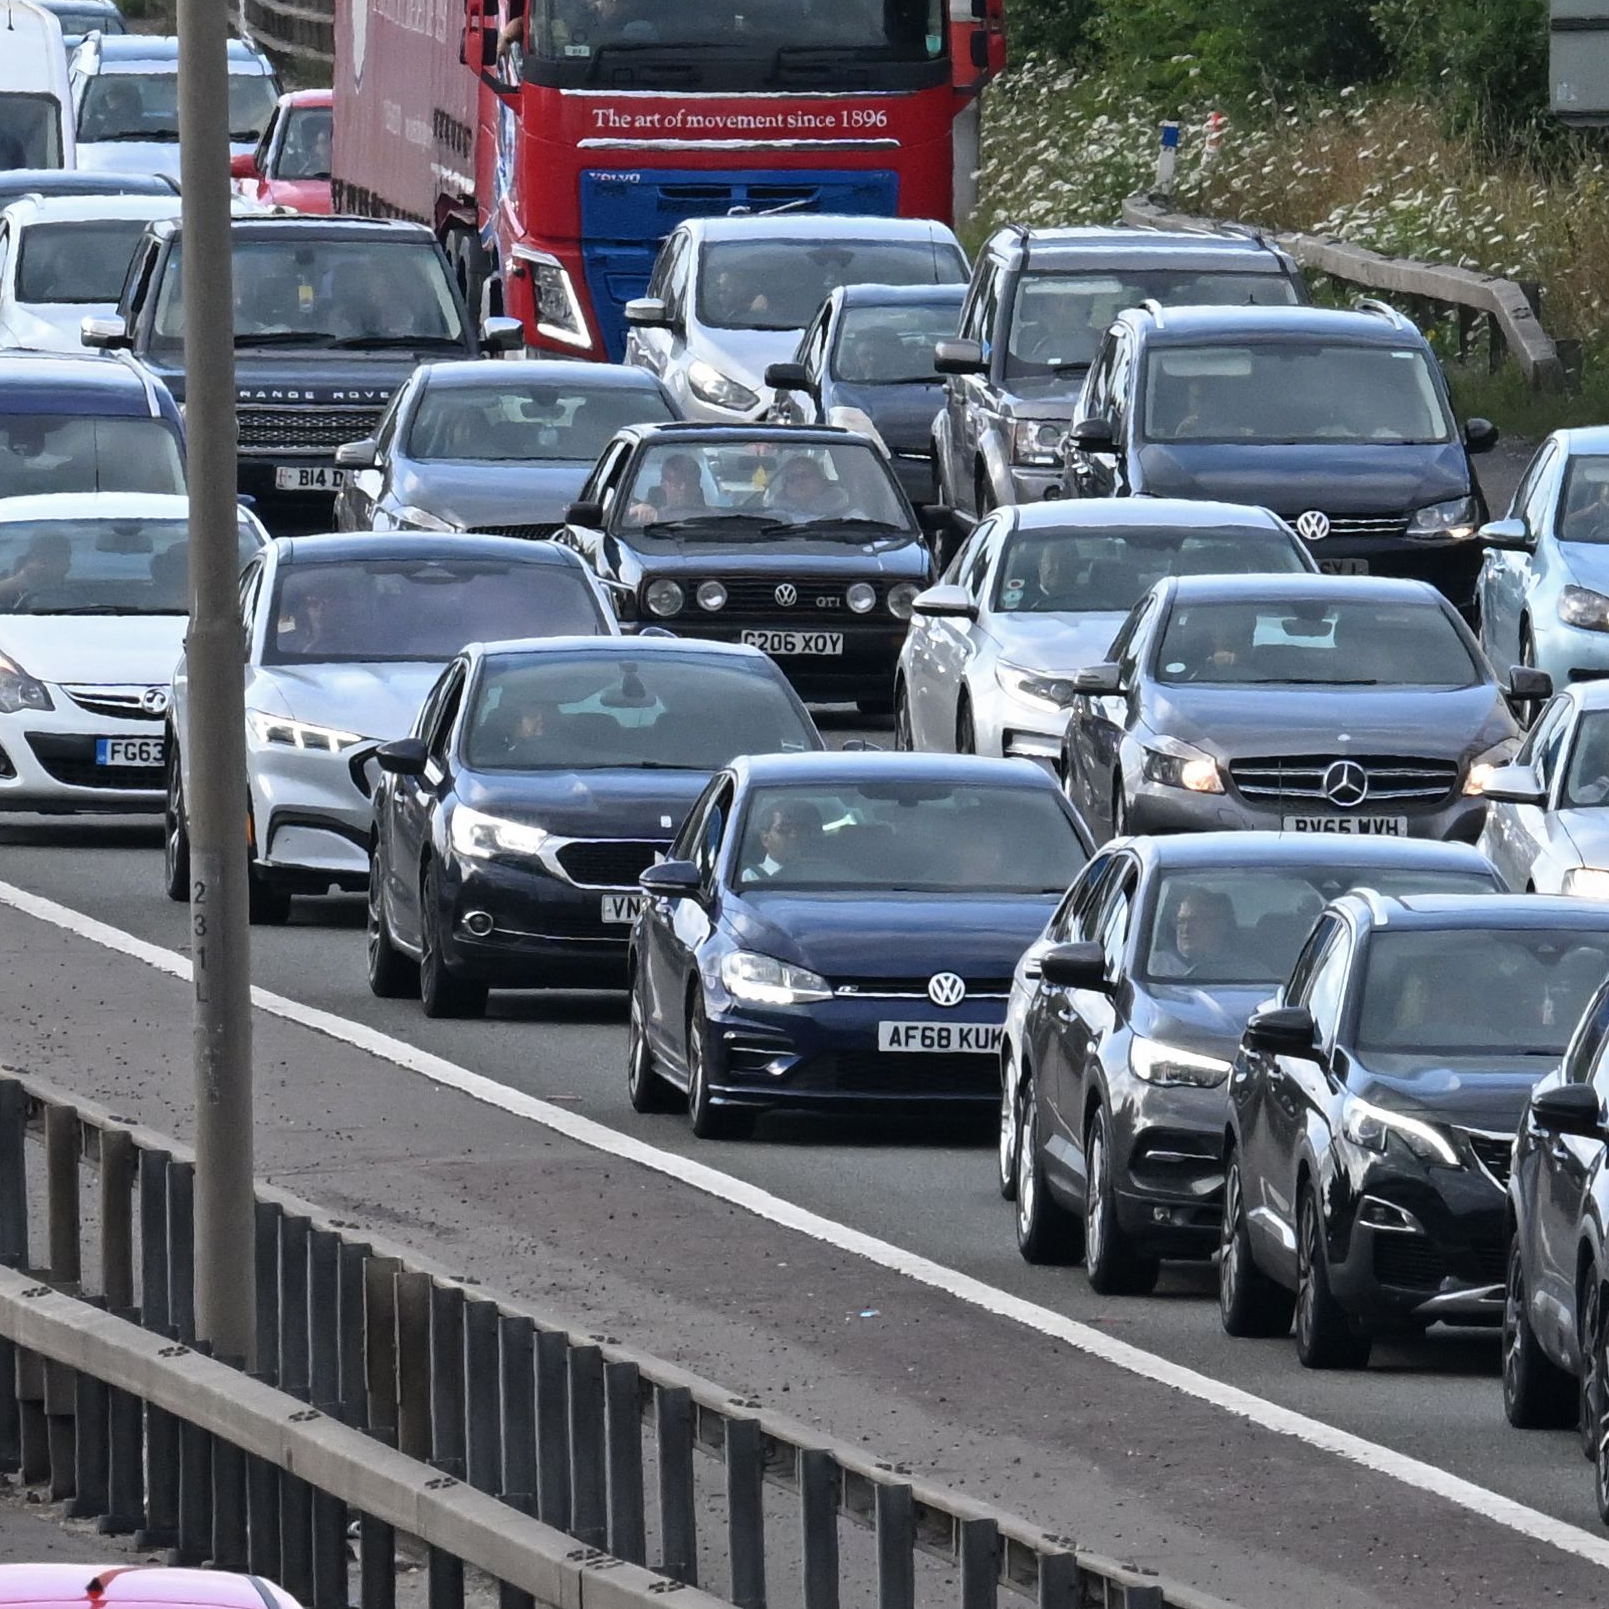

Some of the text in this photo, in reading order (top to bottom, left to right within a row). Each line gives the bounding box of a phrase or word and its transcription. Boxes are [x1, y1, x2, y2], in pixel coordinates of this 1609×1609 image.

[592, 108, 888, 129] The art of movement since 1896
[239, 390, 390, 400] RANGE ROVE
[815, 596, 841, 608] GTI
[802, 633, 842, 653] XOY
[193, 881, 209, 1003] 231L
[888, 1025, 952, 1049] AF68
